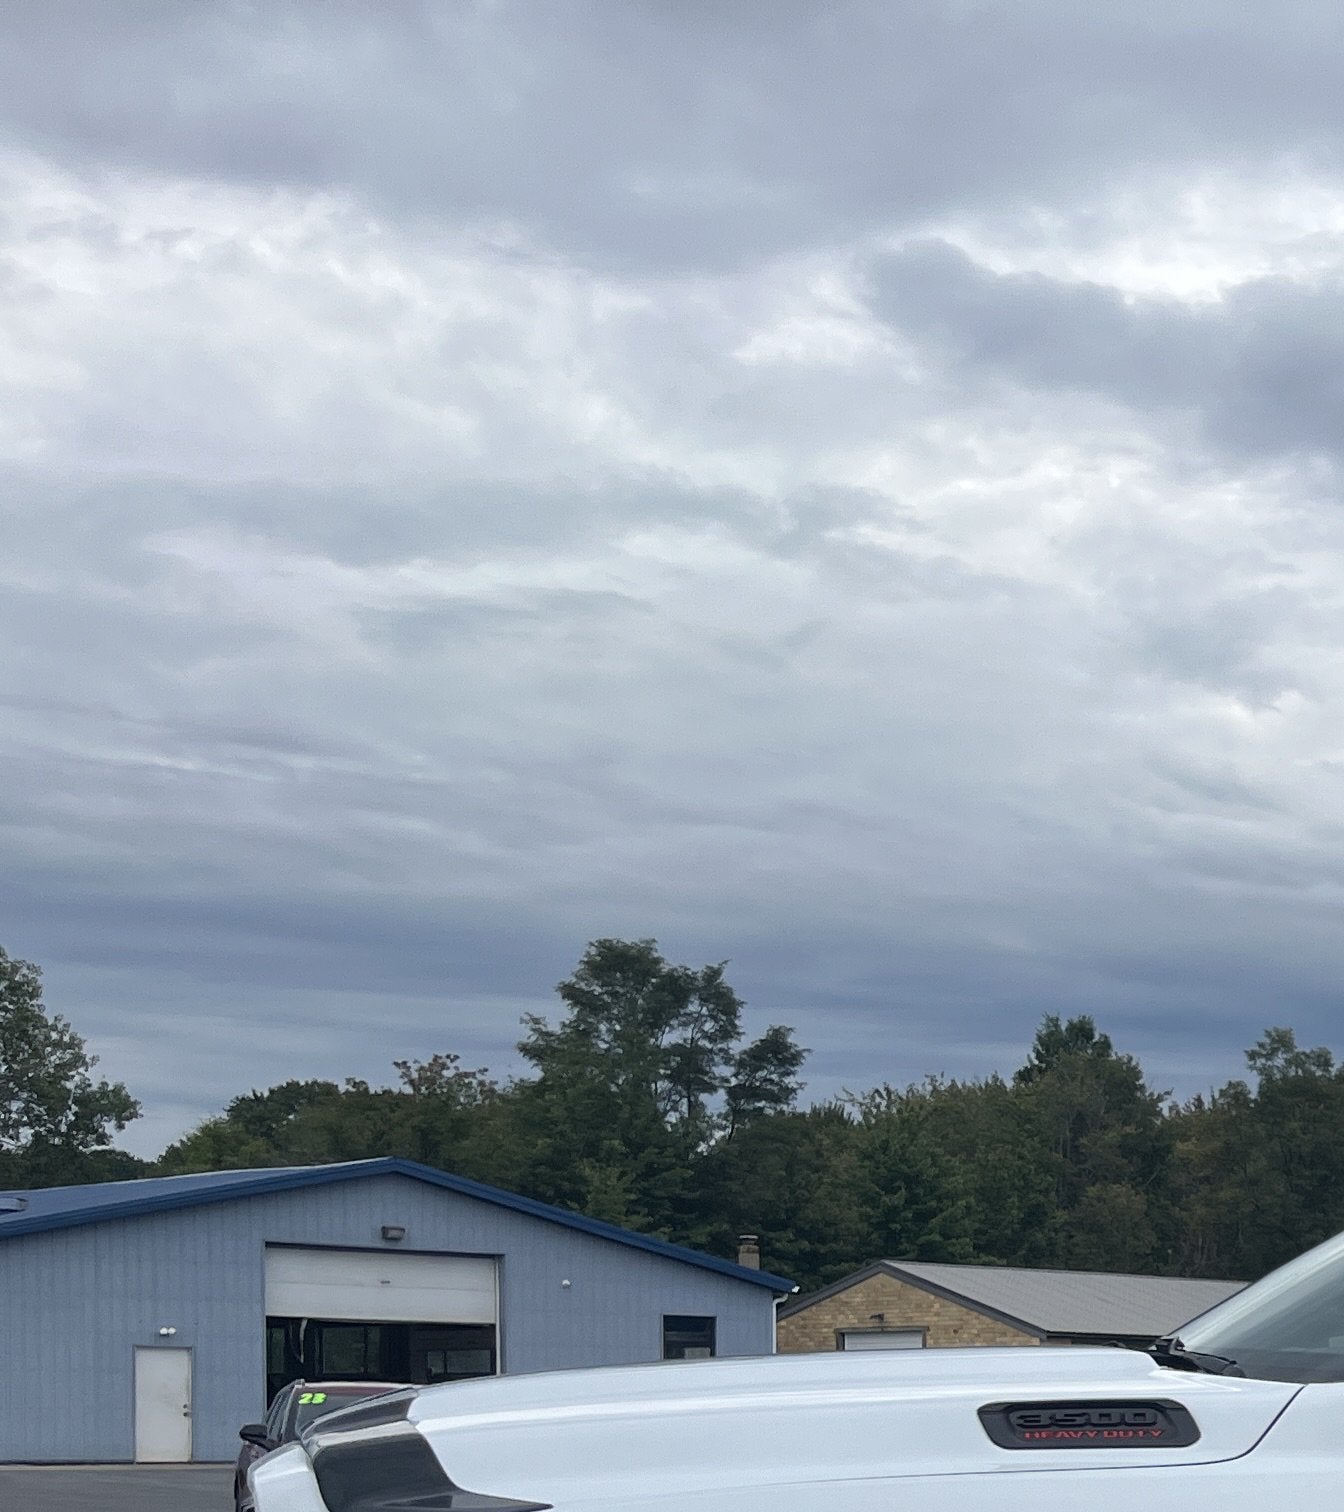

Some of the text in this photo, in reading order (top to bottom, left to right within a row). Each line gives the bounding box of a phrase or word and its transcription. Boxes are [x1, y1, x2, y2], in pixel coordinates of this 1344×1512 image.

[1015, 1409, 1158, 1429] 3500
[1023, 1429, 1166, 1440] HEAVY DUTY
